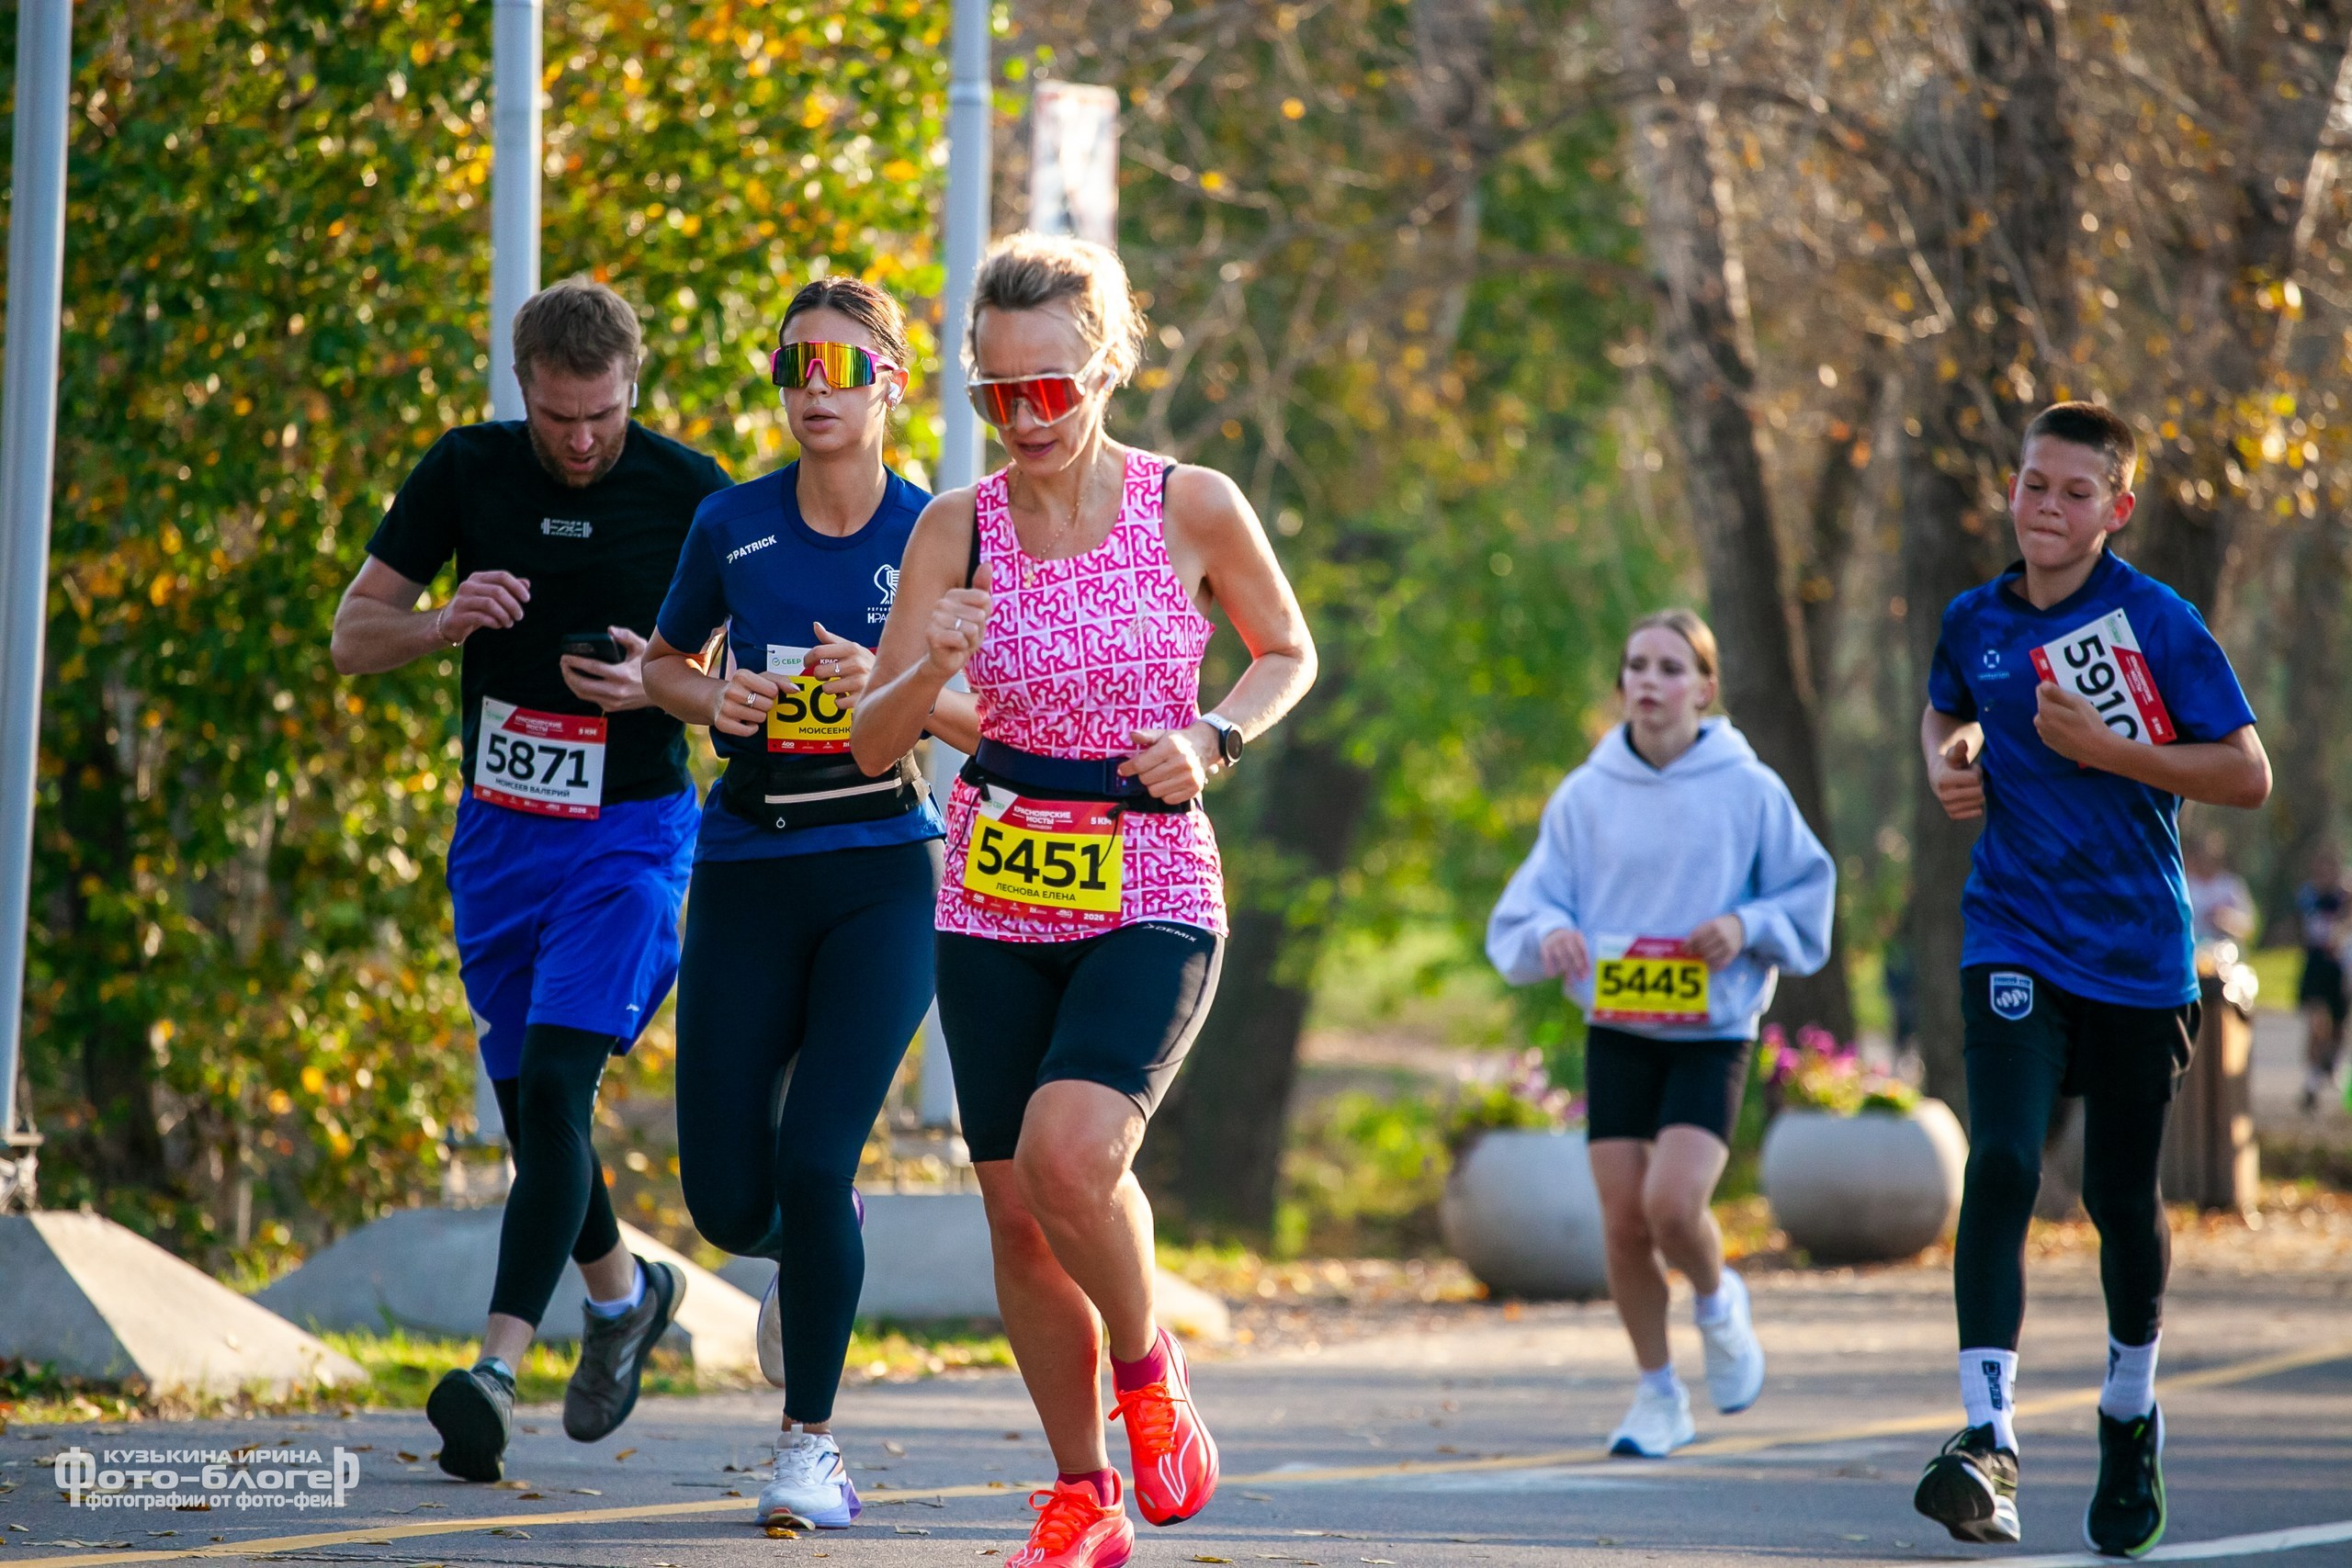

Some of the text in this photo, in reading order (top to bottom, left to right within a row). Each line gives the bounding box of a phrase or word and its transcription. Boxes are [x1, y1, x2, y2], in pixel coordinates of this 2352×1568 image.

[733, 535, 777, 560] PATRICK
[776, 683, 854, 724] 50
[486, 733, 589, 788] 5871
[495, 777, 528, 793] МОИСЕЕВ
[529, 785, 570, 798] ВАЛЕРИЙ
[1013, 805, 1071, 819] КРАСНОЯРСКИЕ
[1025, 815, 1055, 826] МОСТЫ
[1091, 817, 1096, 825] 5
[977, 826, 1106, 891] 5451
[995, 882, 1077, 902] ЛЕСНОВА ЕЛЕНА
[1156, 925, 1197, 942] DEMIX
[1601, 963, 1702, 999] 5445
